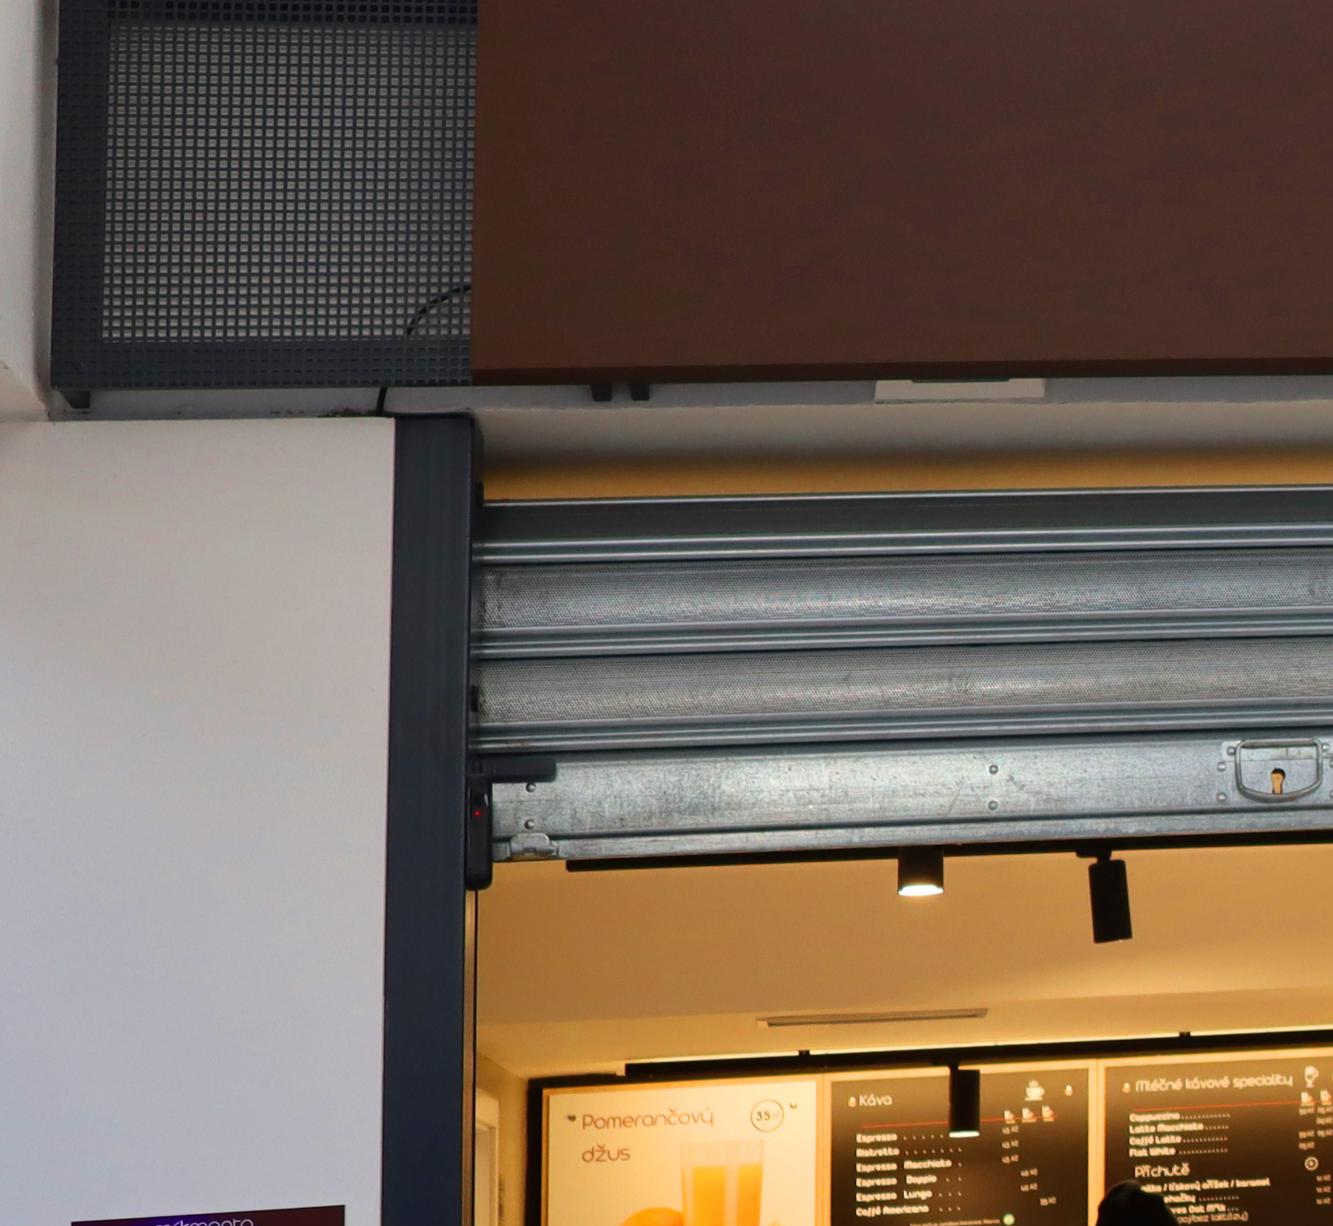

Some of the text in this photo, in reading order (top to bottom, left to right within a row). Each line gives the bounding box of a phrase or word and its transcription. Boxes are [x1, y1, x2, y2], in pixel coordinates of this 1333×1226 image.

[1135, 1073, 1294, 1093] Mléčné kávové speciality
[859, 1094, 894, 1107] Káva
[581, 1106, 715, 1131] Pomerančový
[1129, 1112, 1181, 1123] Cappuccino
[1129, 1121, 1205, 1134] Latte Macchiato
[856, 1133, 898, 1144] Espresso
[1155, 1134, 1183, 1145] Latte
[581, 1143, 632, 1164] džus
[856, 1148, 900, 1158] Ristretto
[1129, 1146, 1177, 1158] Flat White
[856, 1159, 952, 1173] Espresso Macchiato
[1134, 1161, 1191, 1179] Příchutě
[856, 1174, 938, 1188] Espresso Doppio
[1202, 1178, 1230, 1191] oříšek
[856, 1190, 933, 1203] Espresso Lungo
[883, 1204, 930, 1215] Americano
